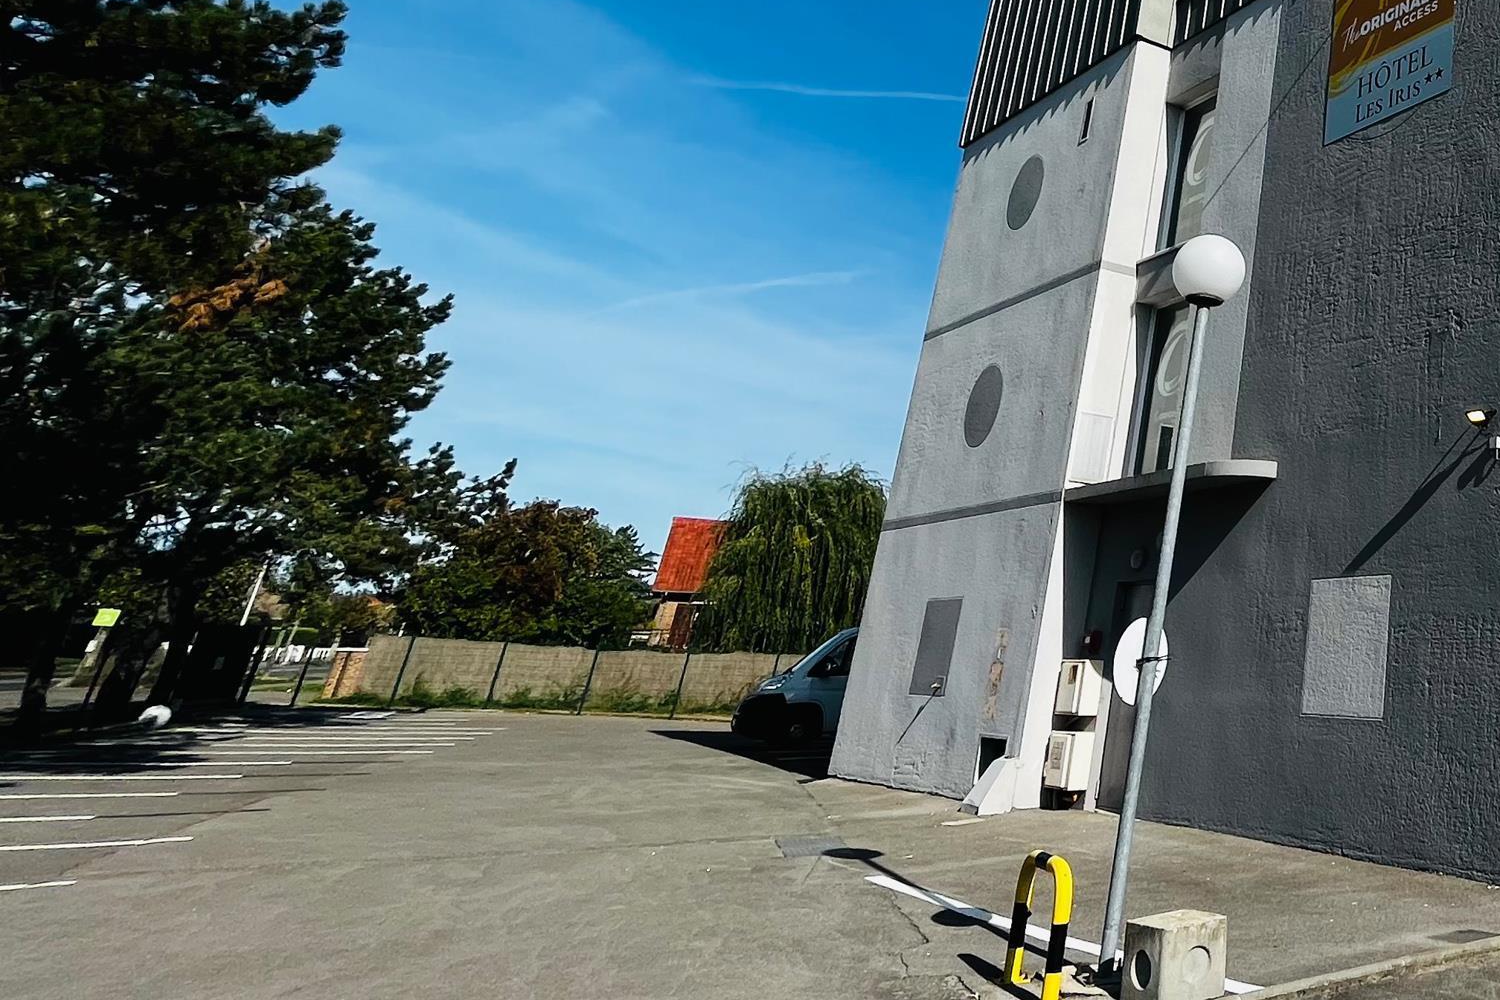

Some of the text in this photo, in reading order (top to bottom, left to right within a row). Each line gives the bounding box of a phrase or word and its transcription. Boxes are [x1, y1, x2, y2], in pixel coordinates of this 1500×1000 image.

[1394, 1, 1439, 32] ACCESS
[1357, 46, 1433, 99] HÔTEL
[1355, 80, 1421, 124] LES IRIS
